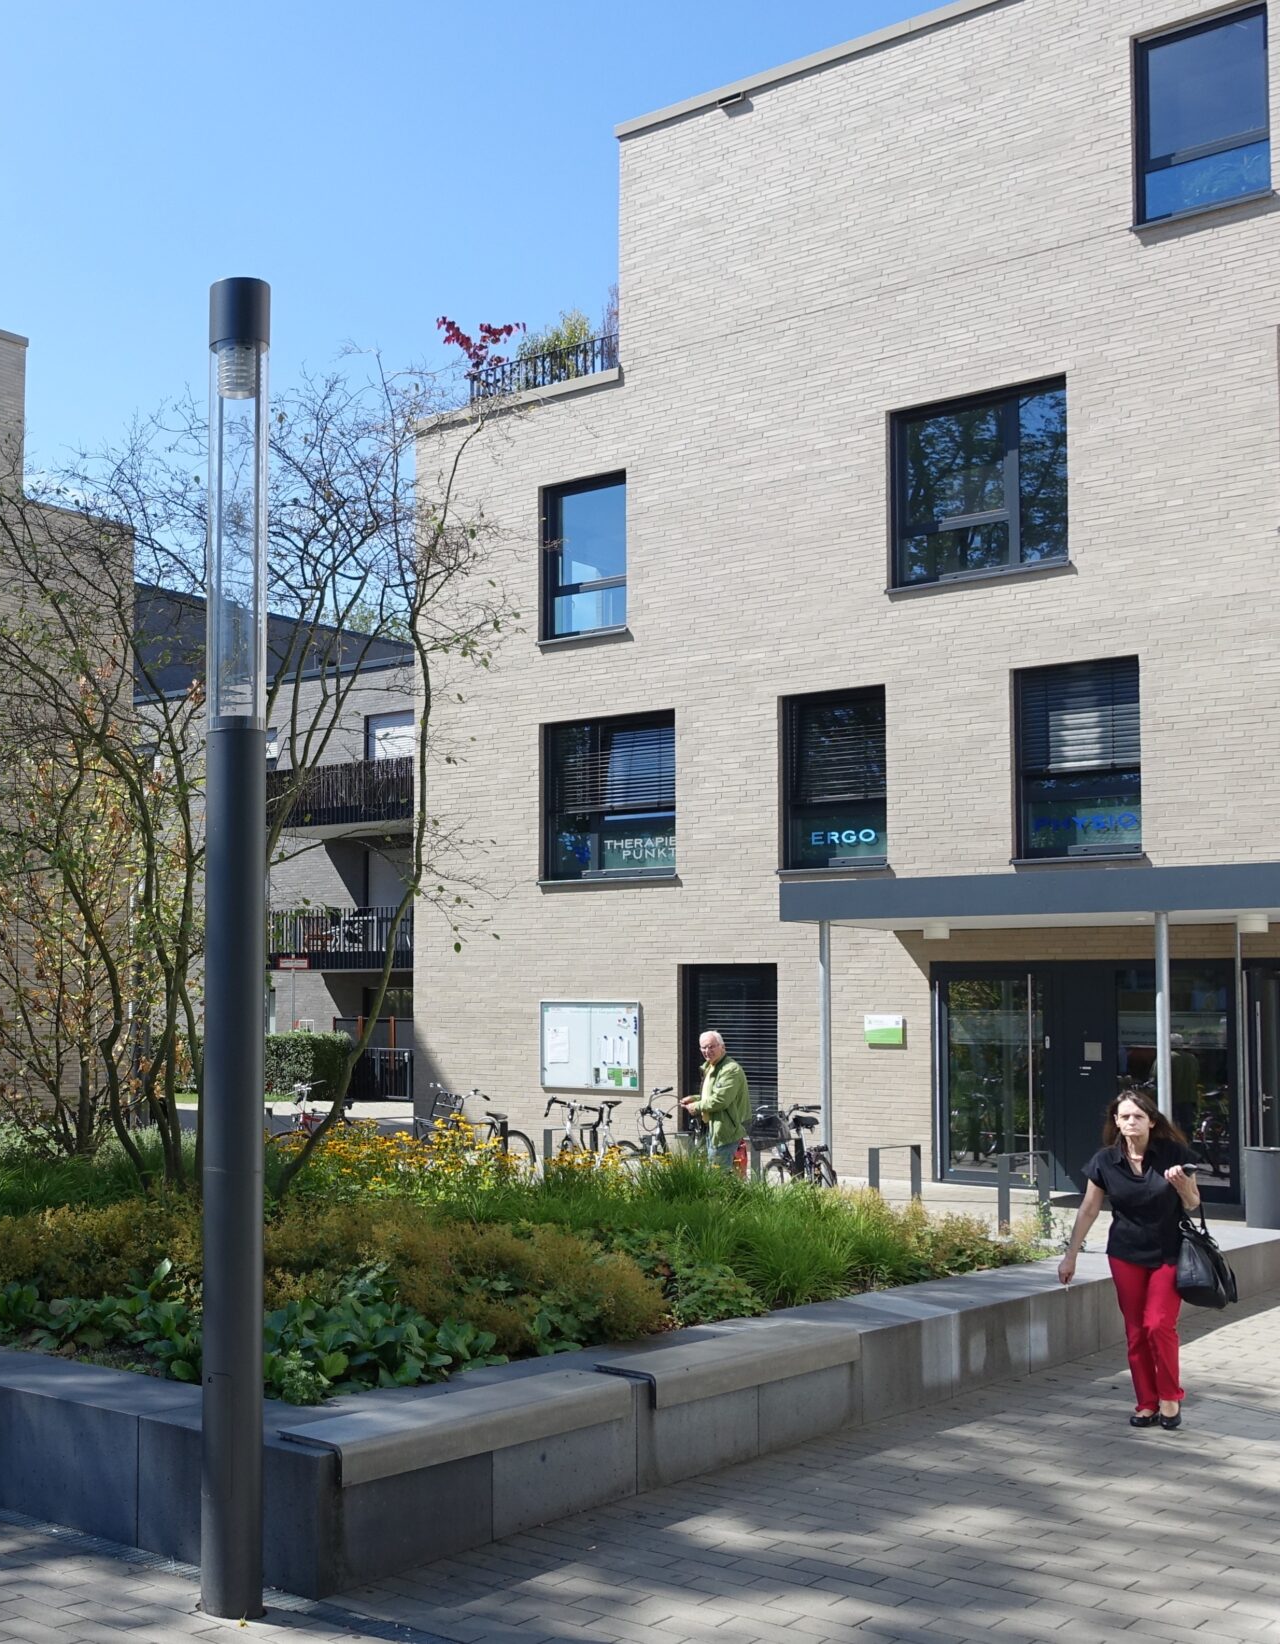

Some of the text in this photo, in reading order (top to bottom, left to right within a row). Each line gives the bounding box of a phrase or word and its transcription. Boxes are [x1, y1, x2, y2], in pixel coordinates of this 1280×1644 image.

[1035, 811, 1138, 832] PHYSIO
[604, 836, 677, 850] THERAPIE
[811, 829, 876, 845] ERGO
[622, 848, 676, 860] PUNKT
